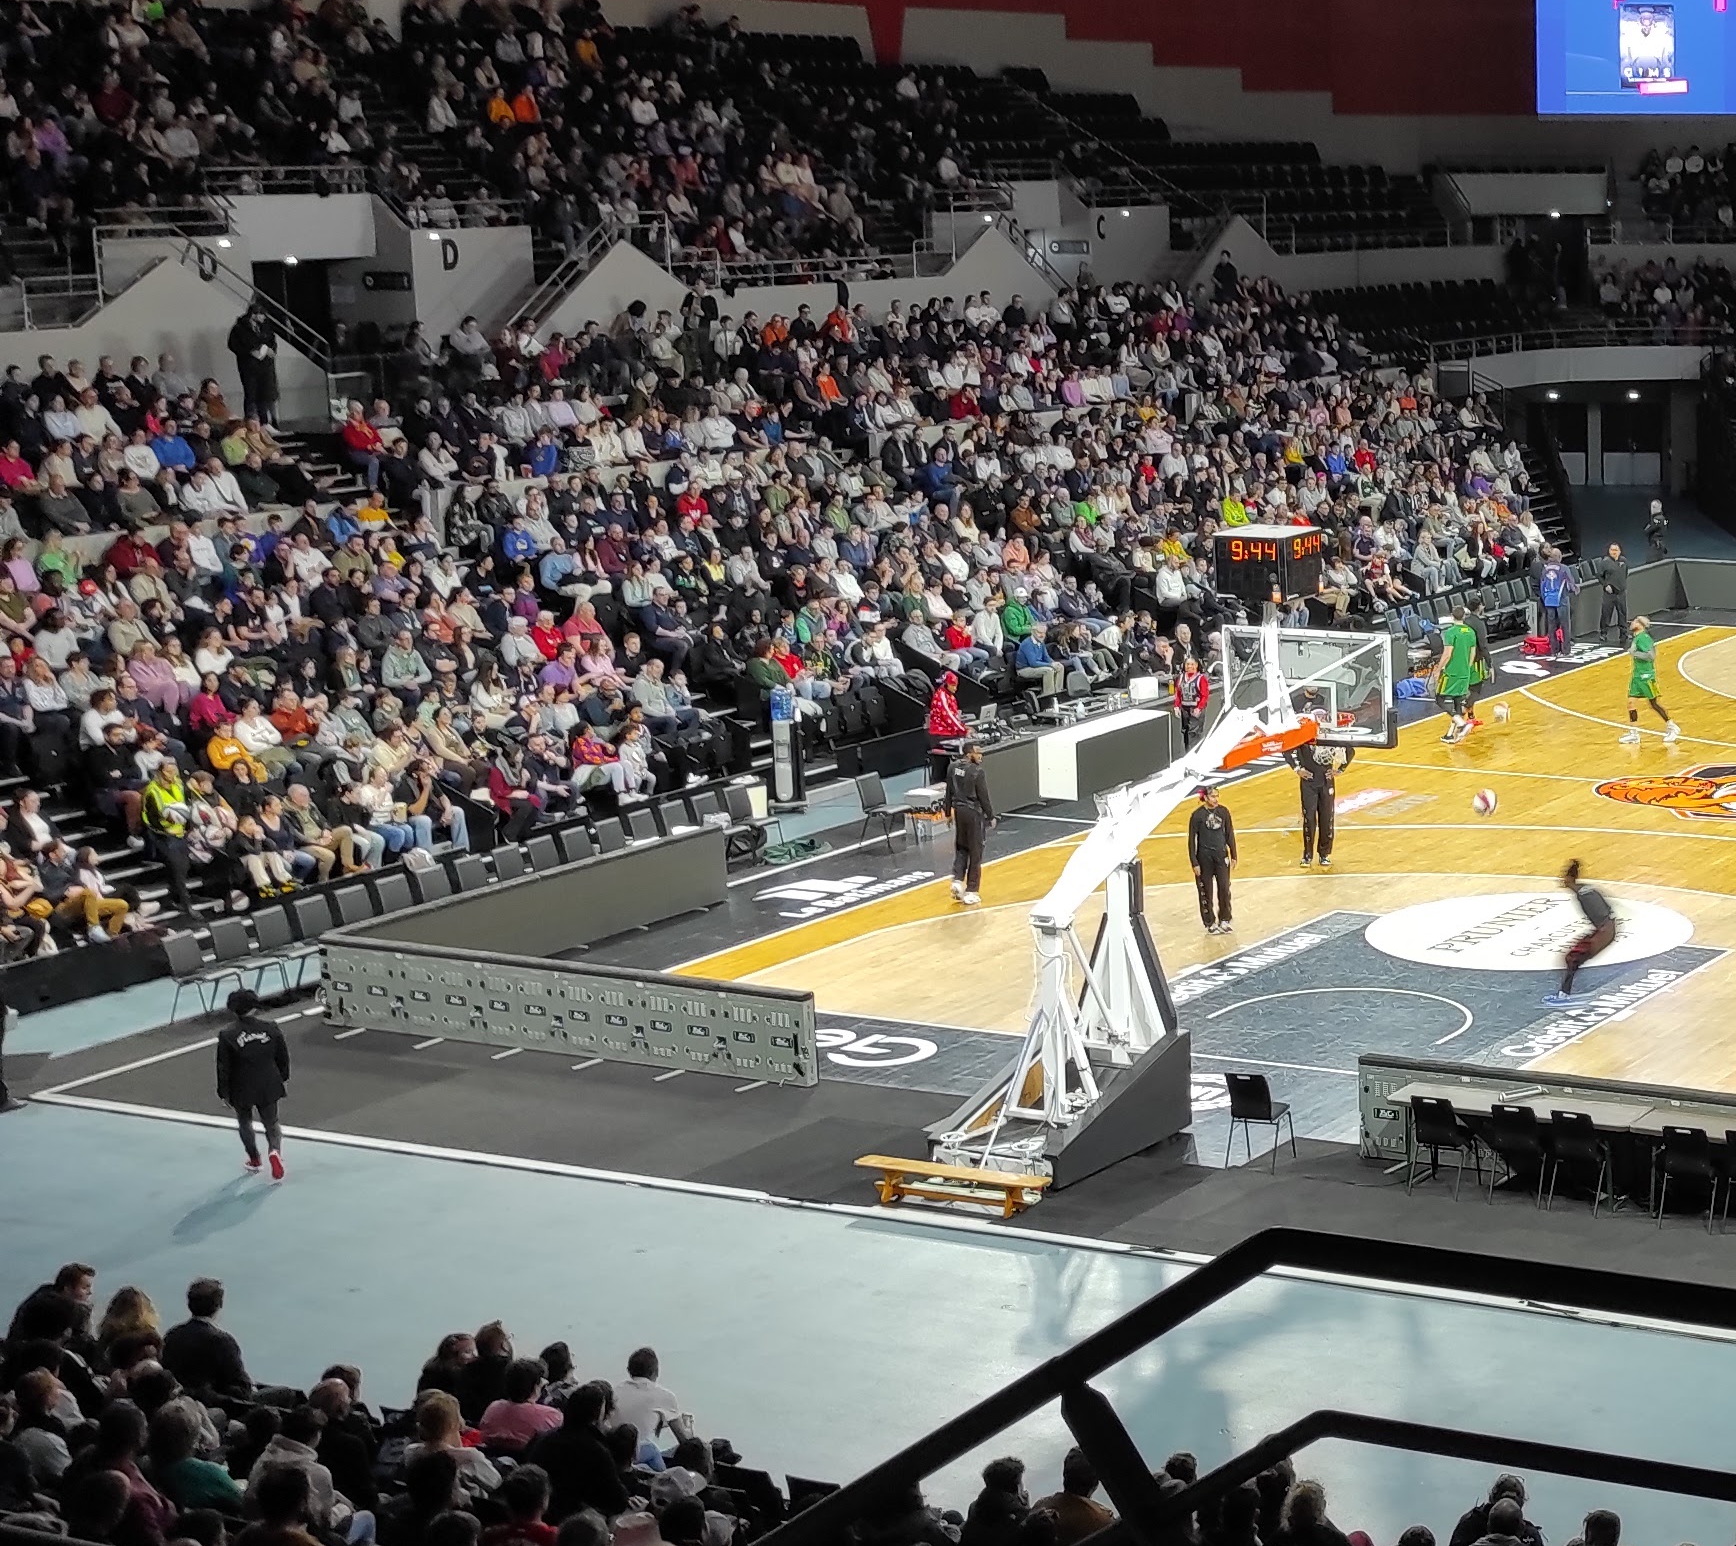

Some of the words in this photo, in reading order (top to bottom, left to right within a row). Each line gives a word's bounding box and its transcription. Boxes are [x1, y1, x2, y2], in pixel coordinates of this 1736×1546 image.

[1096, 214, 1106, 240] C
[442, 239, 459, 271] D
[1231, 540, 1276, 562] 9:44
[1293, 534, 1321, 559] 9:44
[778, 906, 826, 918] Le
[1428, 896, 1572, 954] PRUNIER
[1225, 932, 1331, 969] Mutuel
[1500, 1019, 1600, 1057] Crédit
[1589, 968, 1685, 1009] Mutuel
